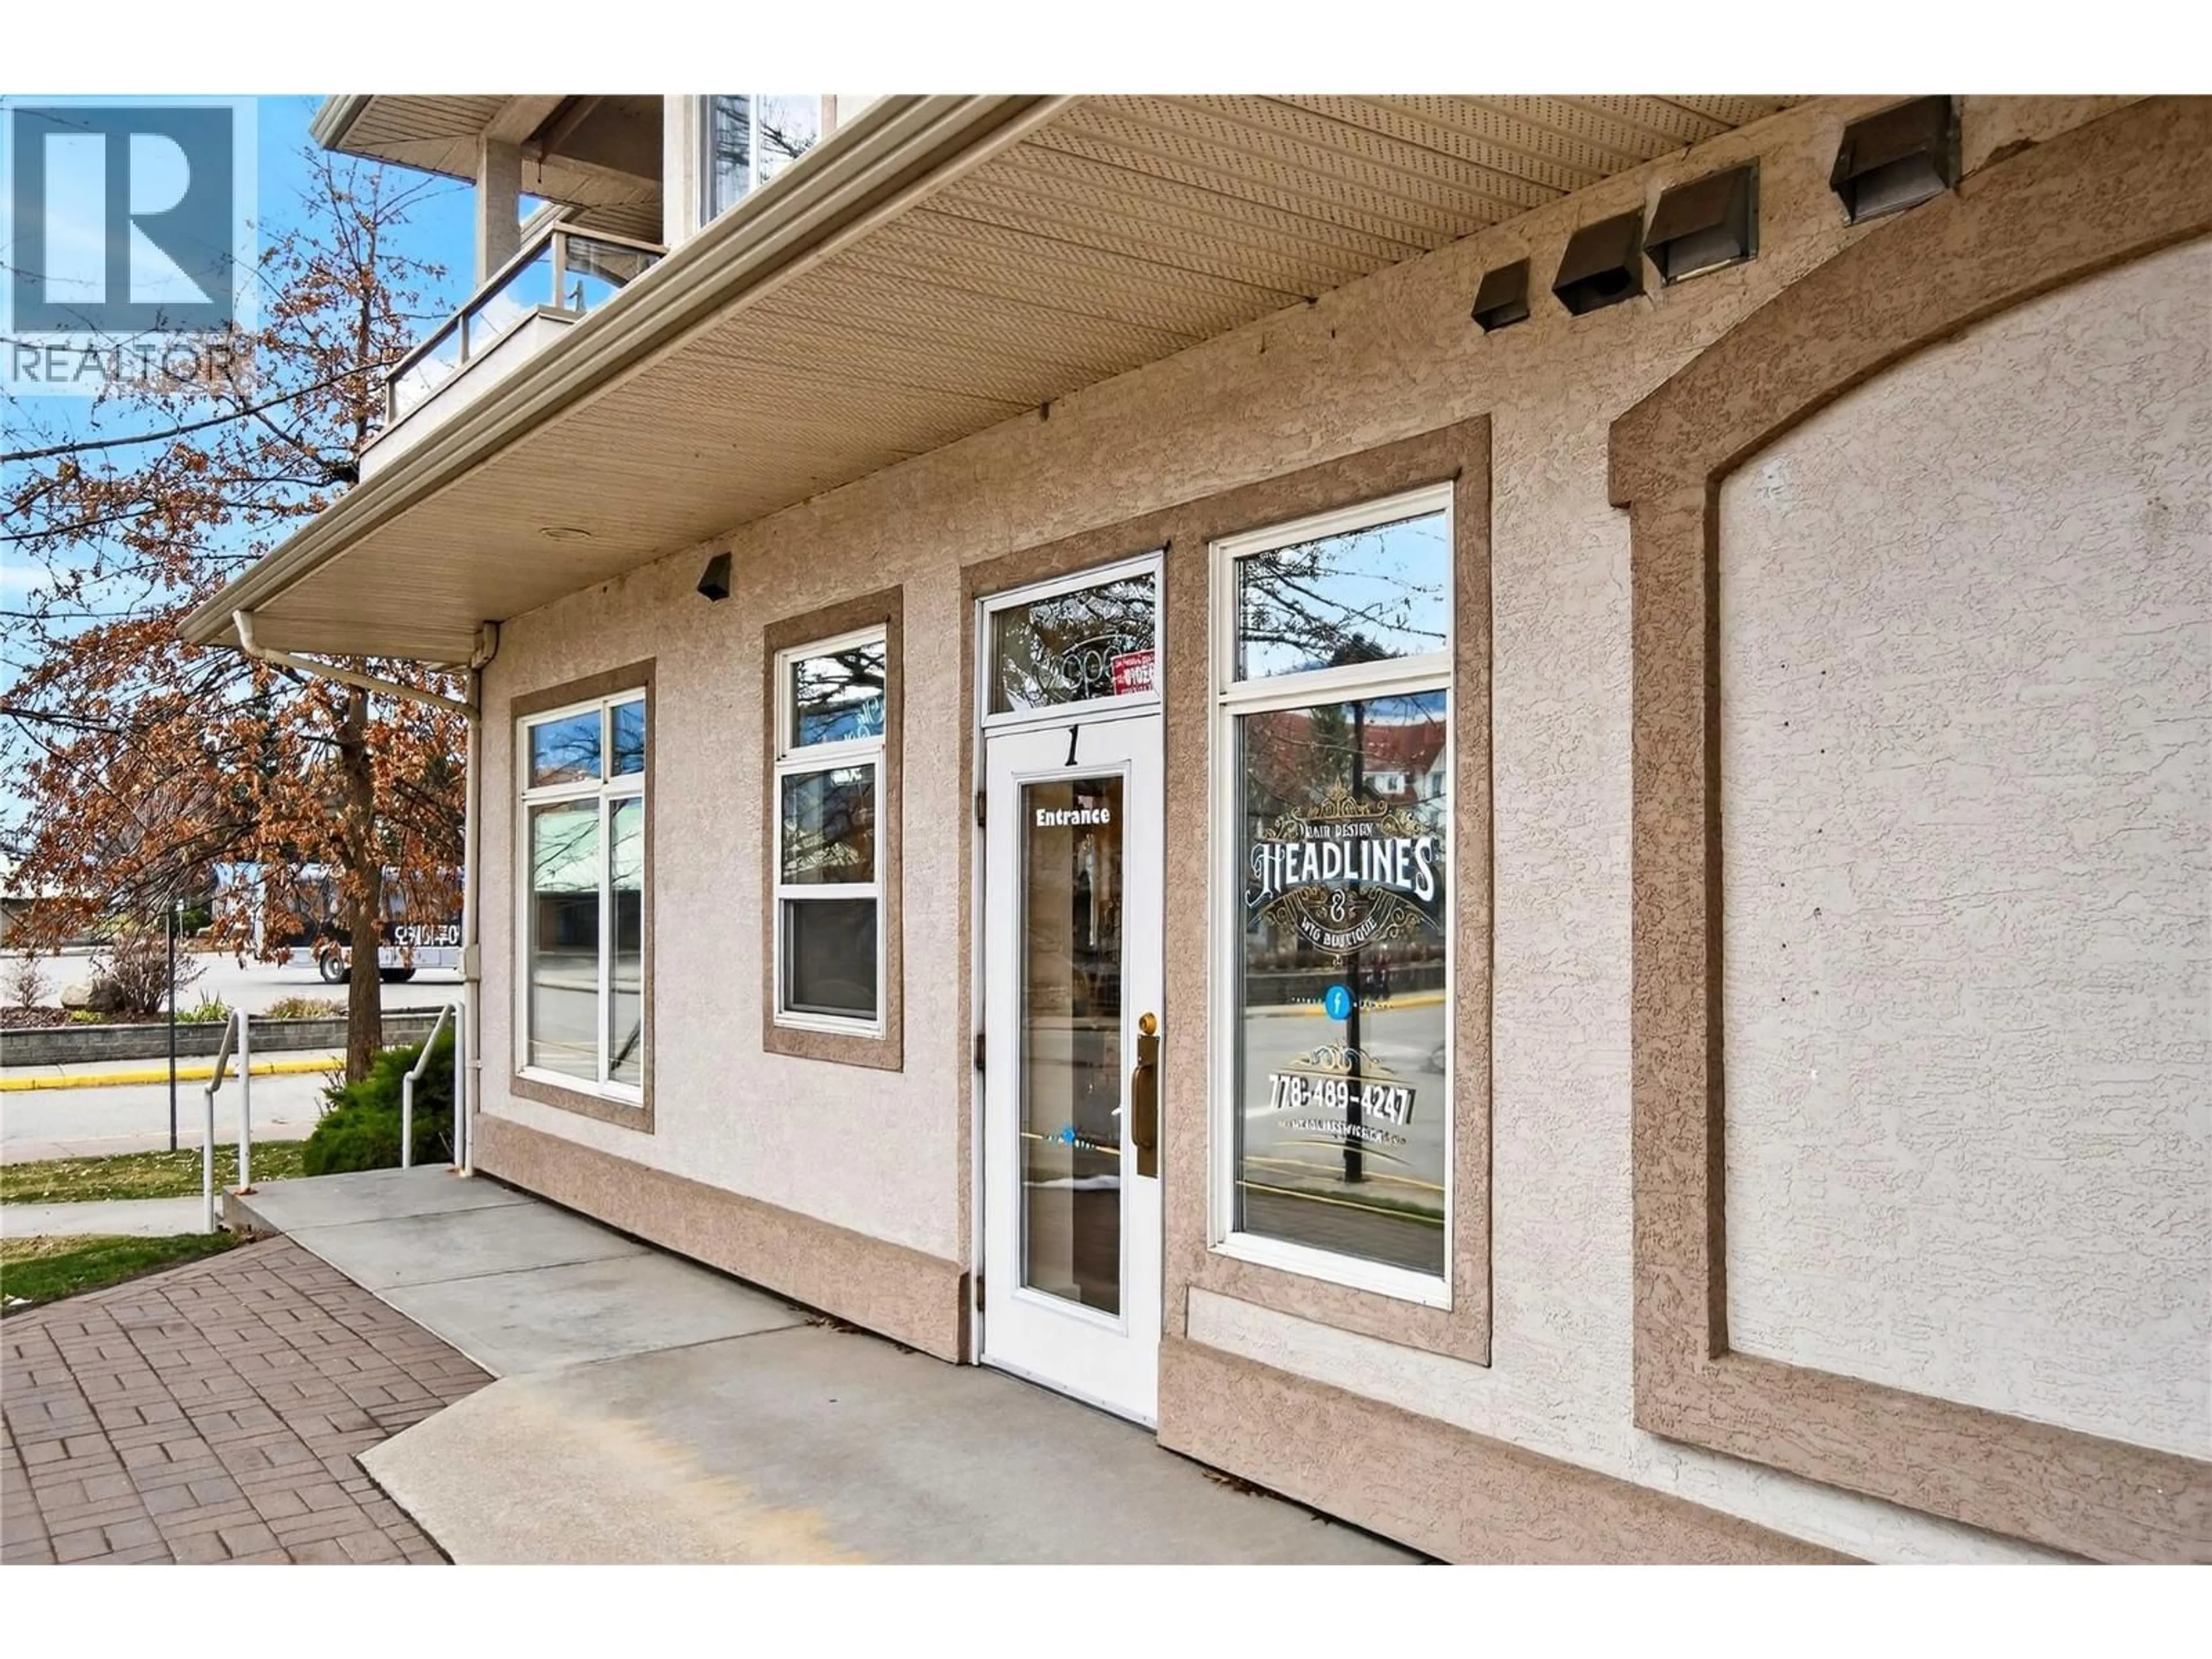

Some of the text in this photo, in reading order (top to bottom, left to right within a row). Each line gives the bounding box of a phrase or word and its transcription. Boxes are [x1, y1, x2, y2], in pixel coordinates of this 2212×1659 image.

[1064, 724, 1078, 766] 1
[1036, 807, 1111, 827] Entrance
[1245, 836, 1434, 908] HEADLINES
[1268, 1074, 1412, 1125] 778-489-4247
